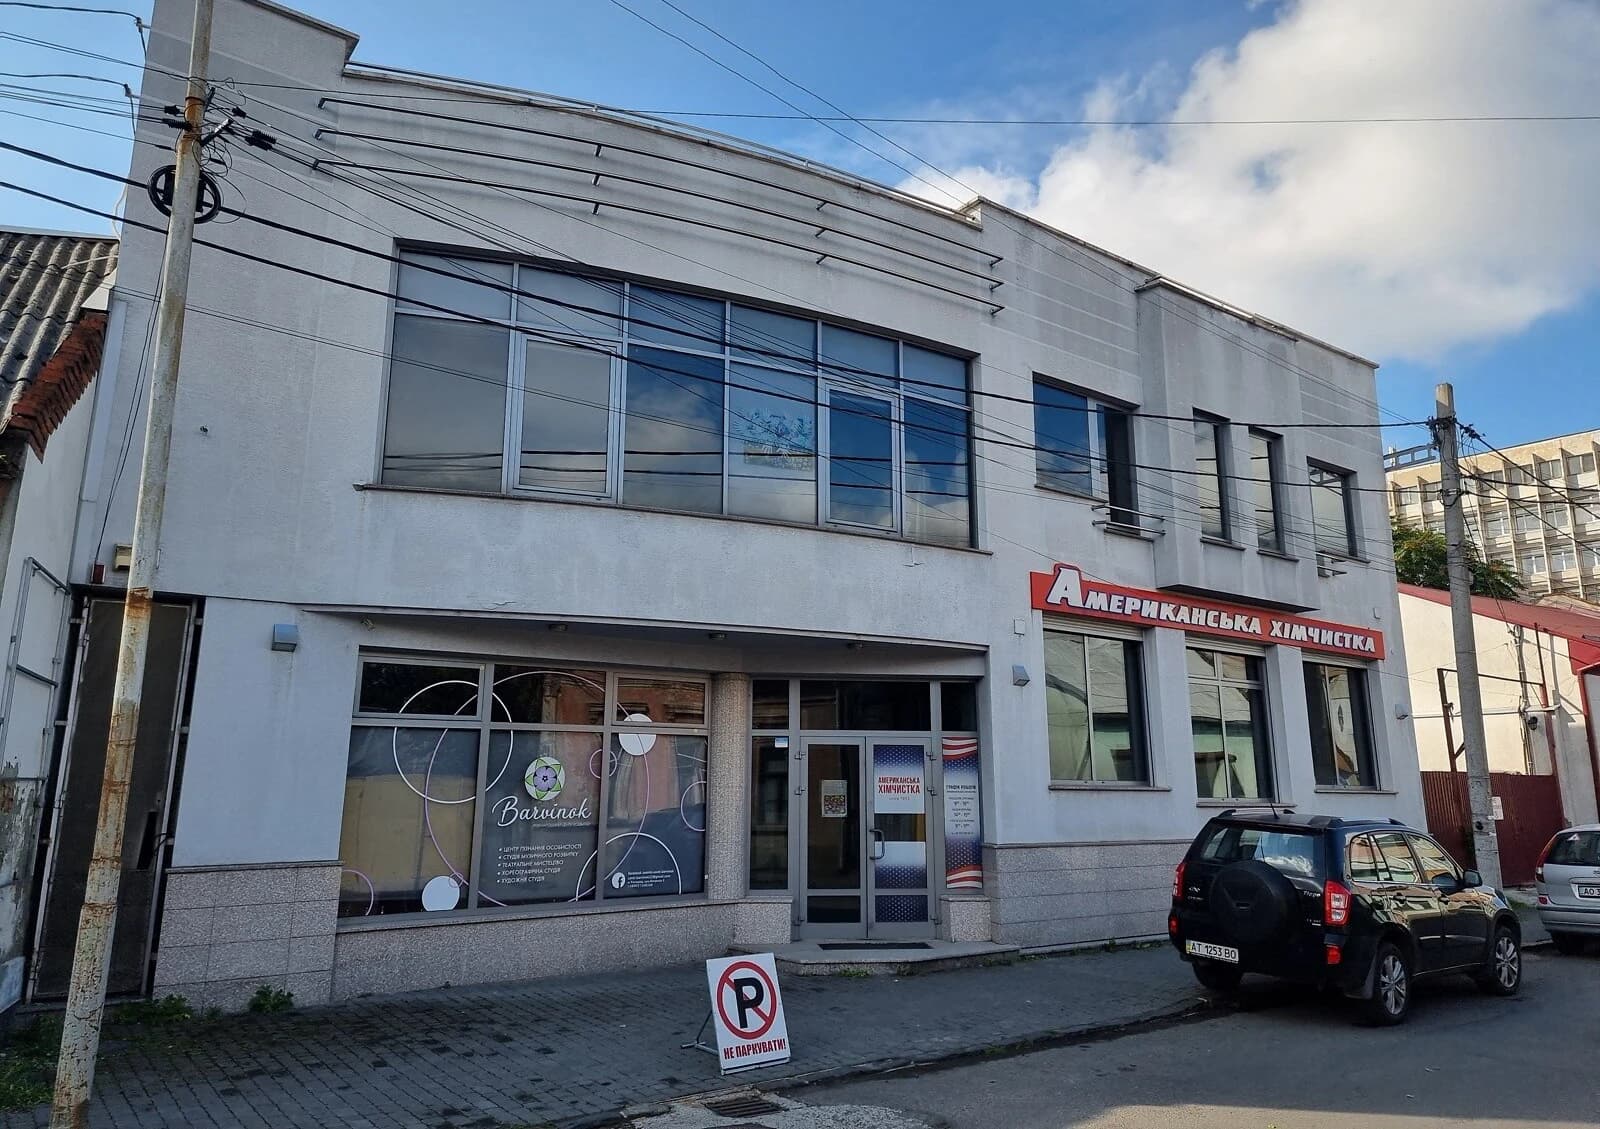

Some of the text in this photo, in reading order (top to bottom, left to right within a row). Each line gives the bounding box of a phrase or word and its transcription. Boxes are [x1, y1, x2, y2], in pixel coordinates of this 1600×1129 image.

[1046, 566, 1376, 653] АМЕРИКАНСЬКА ХІМЧИСТКА
[878, 776, 920, 784] АМЕРИКАНСЬКА
[878, 784, 920, 794] ХІМЧИСТКА
[491, 795, 592, 827] Barvinok
[1204, 945, 1222, 957] 1253
[723, 1038, 786, 1060] НЕ ПАРКУВАТИ!
